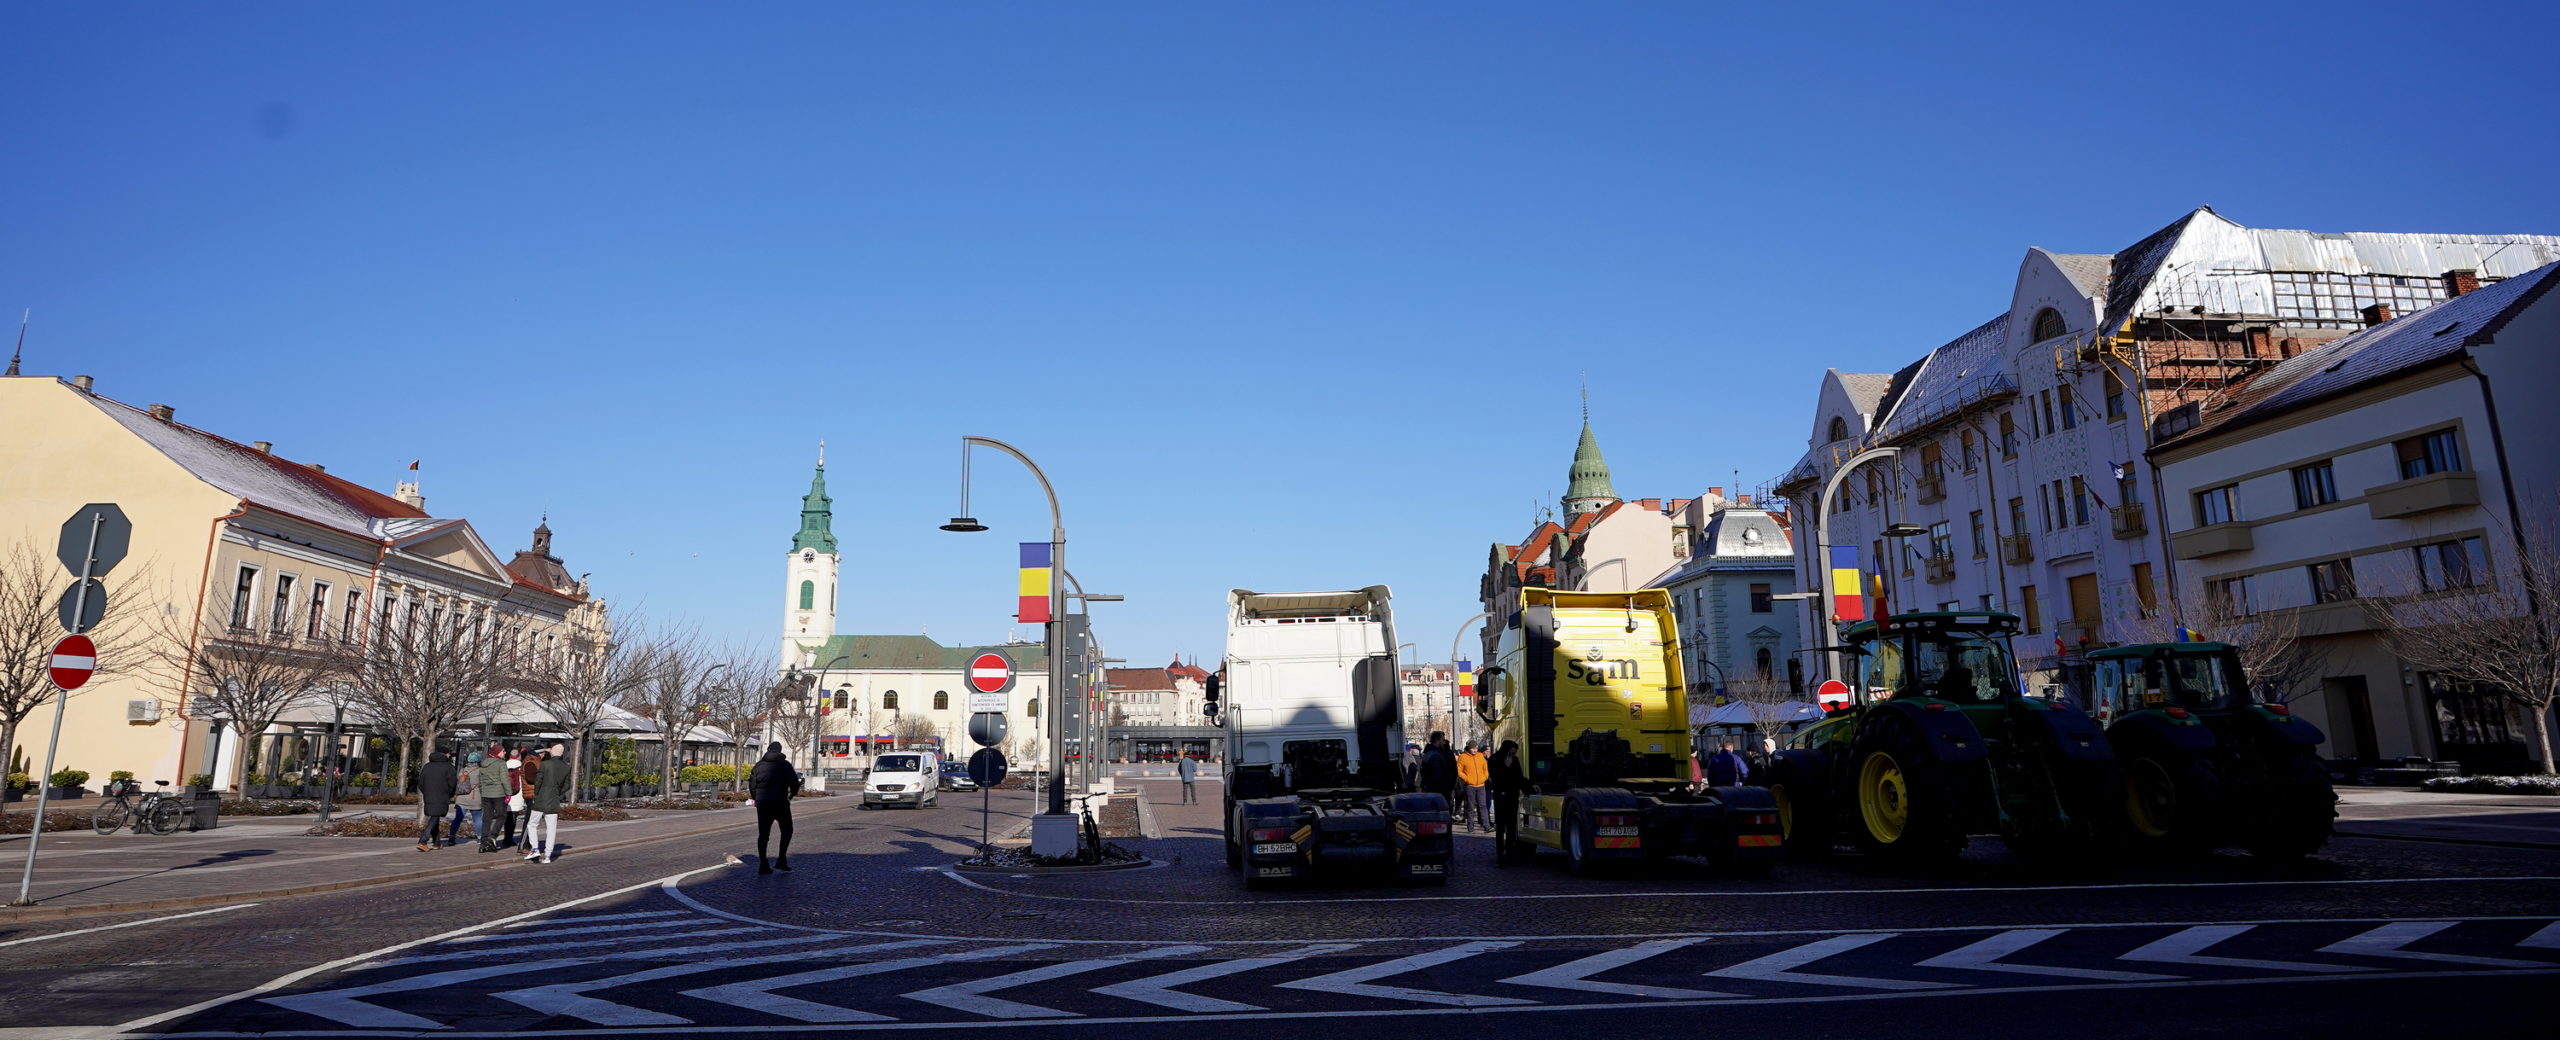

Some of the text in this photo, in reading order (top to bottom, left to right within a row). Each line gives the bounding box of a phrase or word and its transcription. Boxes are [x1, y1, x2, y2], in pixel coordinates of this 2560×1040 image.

[1257, 844, 1269, 853] BH
[1259, 866, 1292, 875] DAF
[1411, 864, 1443, 872] DAF
